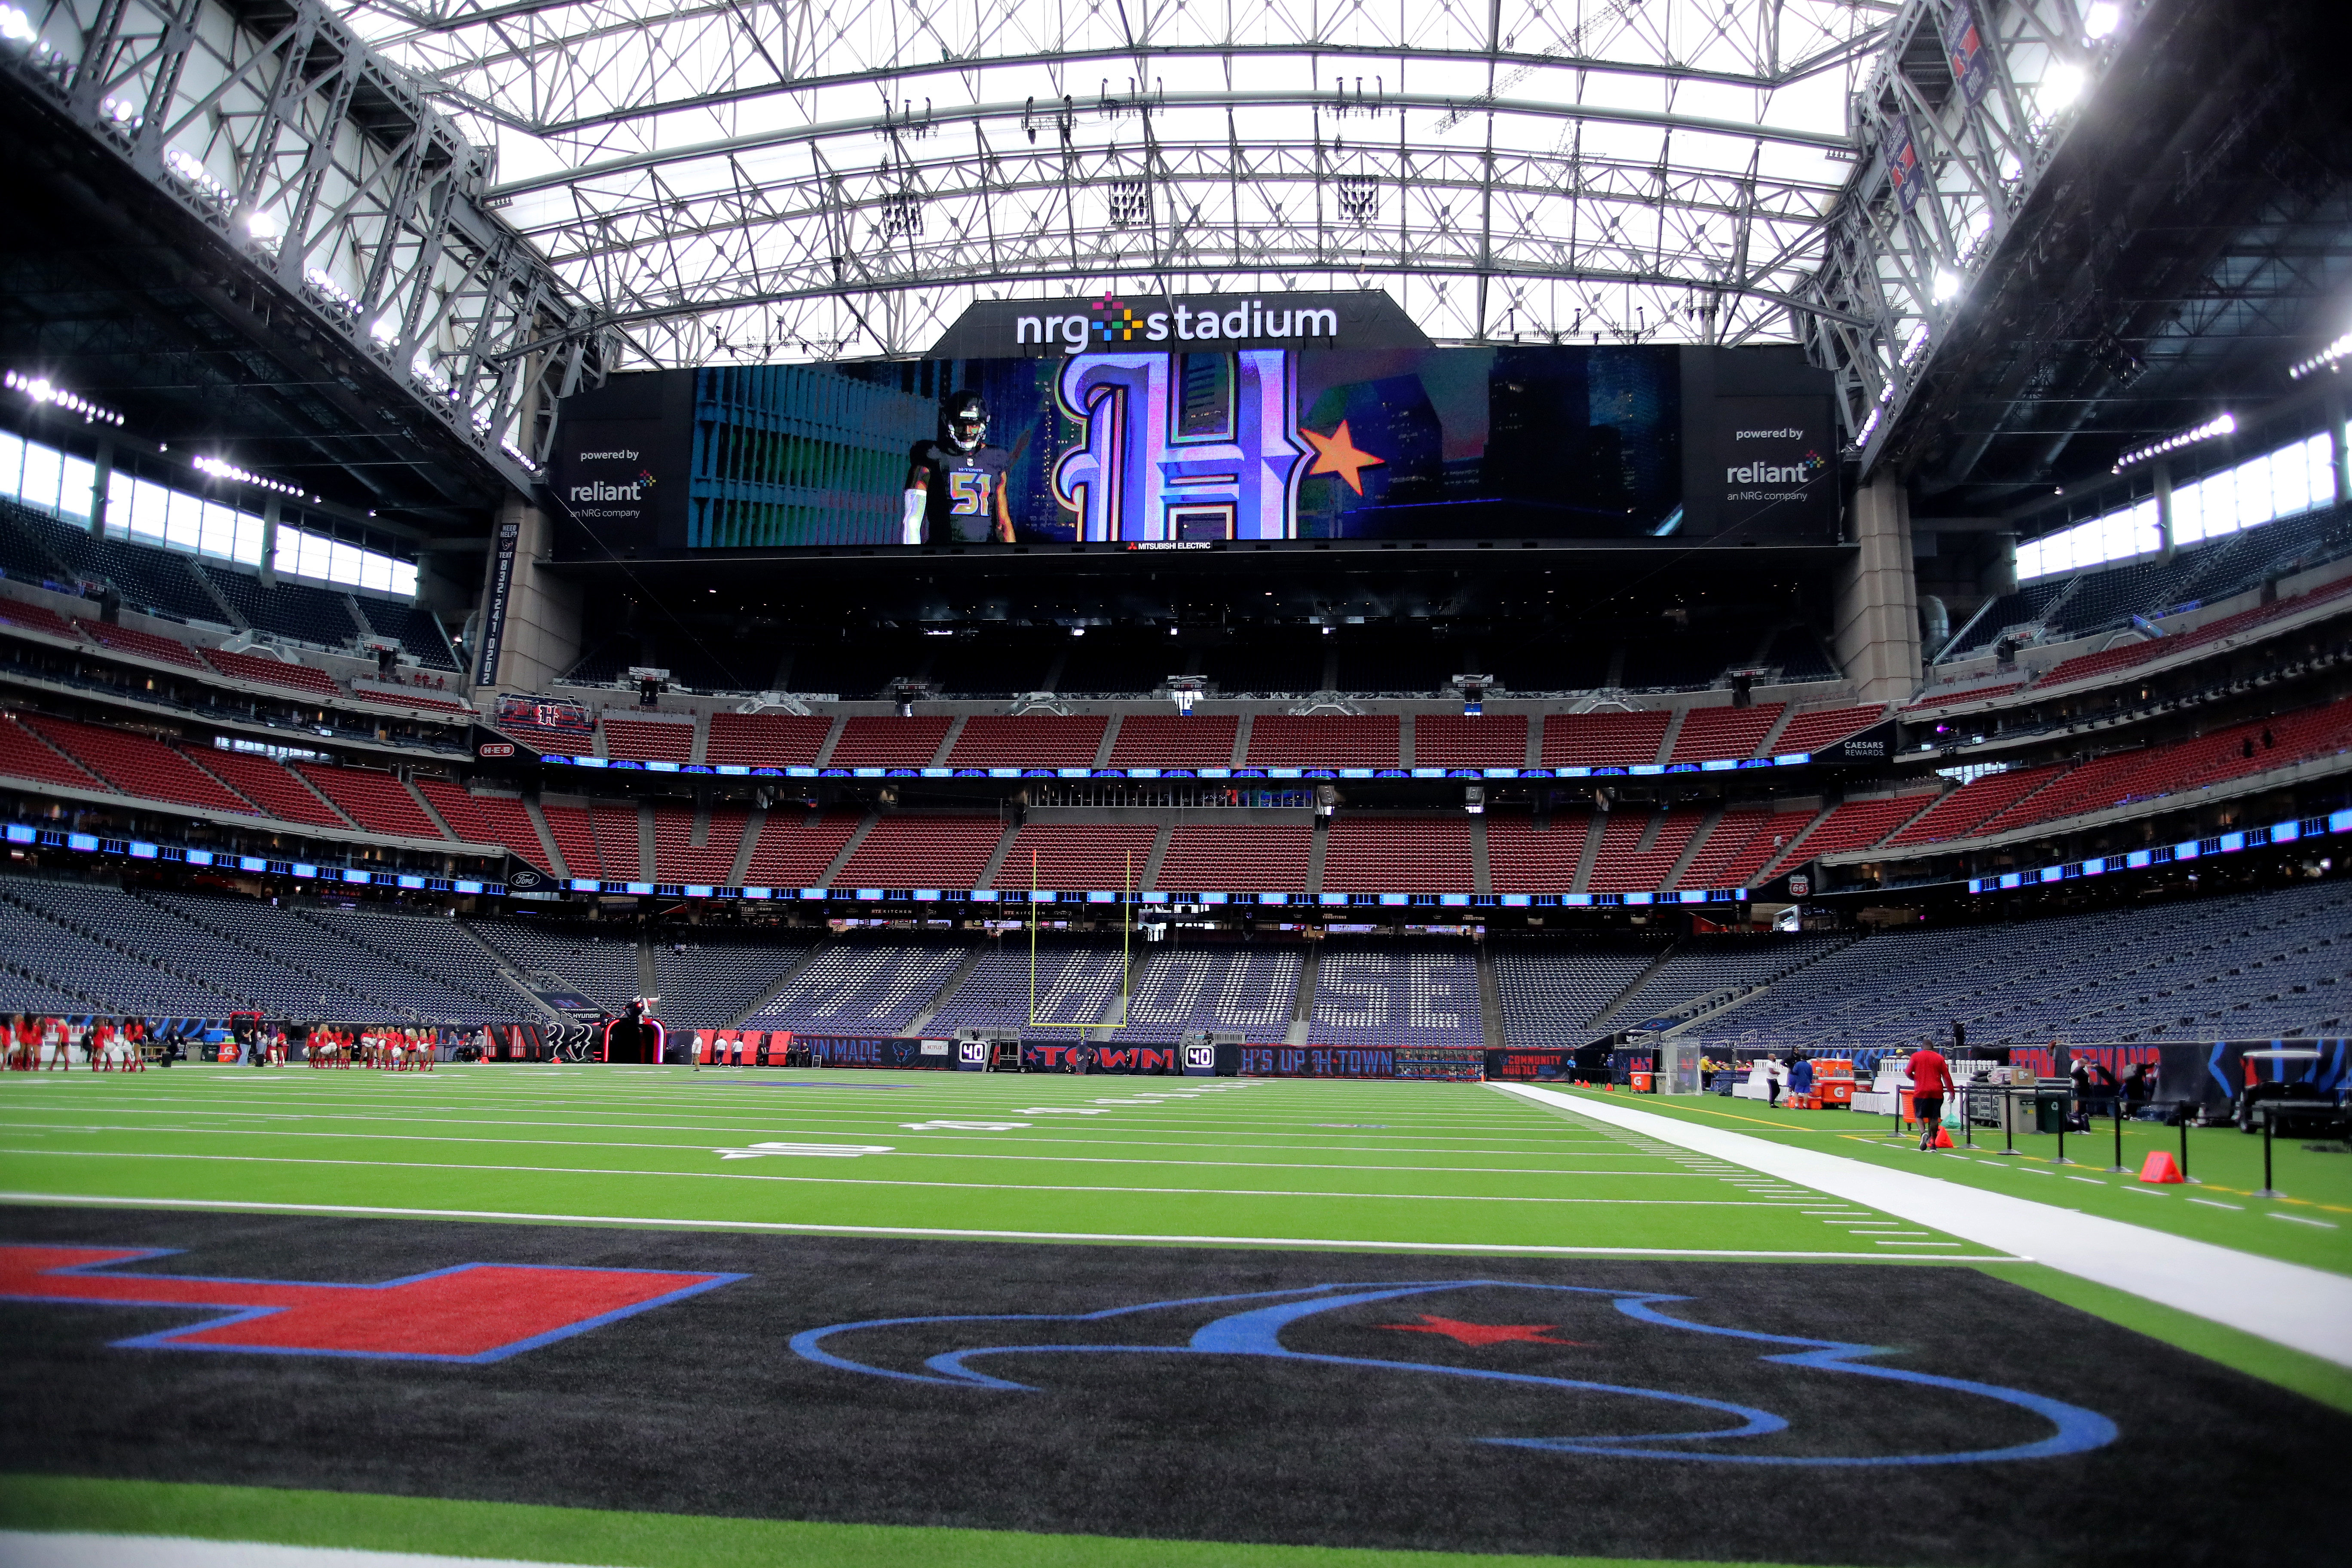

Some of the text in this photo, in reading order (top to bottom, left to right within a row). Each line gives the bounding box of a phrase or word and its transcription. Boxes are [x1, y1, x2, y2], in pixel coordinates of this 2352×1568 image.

[1966, 66, 1983, 98] 2012
[1904, 179, 1916, 205] 2011
[1017, 300, 1337, 354] nrg stadium
[1736, 428, 1803, 441] powered by
[581, 450, 639, 462] powered by
[1727, 461, 1809, 483] reliant
[571, 481, 642, 501] reliant
[949, 472, 992, 517] 51
[1740, 491, 1762, 500] NRG
[1764, 493, 1807, 502] company
[603, 510, 640, 518] company
[516, 873, 535, 885] Ford
[1031, 949, 1462, 1027] HOUSE
[834, 1040, 882, 1062] MADE
[963, 1044, 983, 1060] 40
[1190, 1049, 1210, 1065] 40
[1241, 1049, 1273, 1072] H'S
[1279, 1049, 1305, 1072] UP
[1508, 1055, 1562, 1065] COMMUNITY
[1502, 1065, 1538, 1075] HUDDLE
[1633, 1076, 1642, 1086] G
[1834, 1086, 1844, 1098] G
[2147, 1156, 2164, 1179] 10
